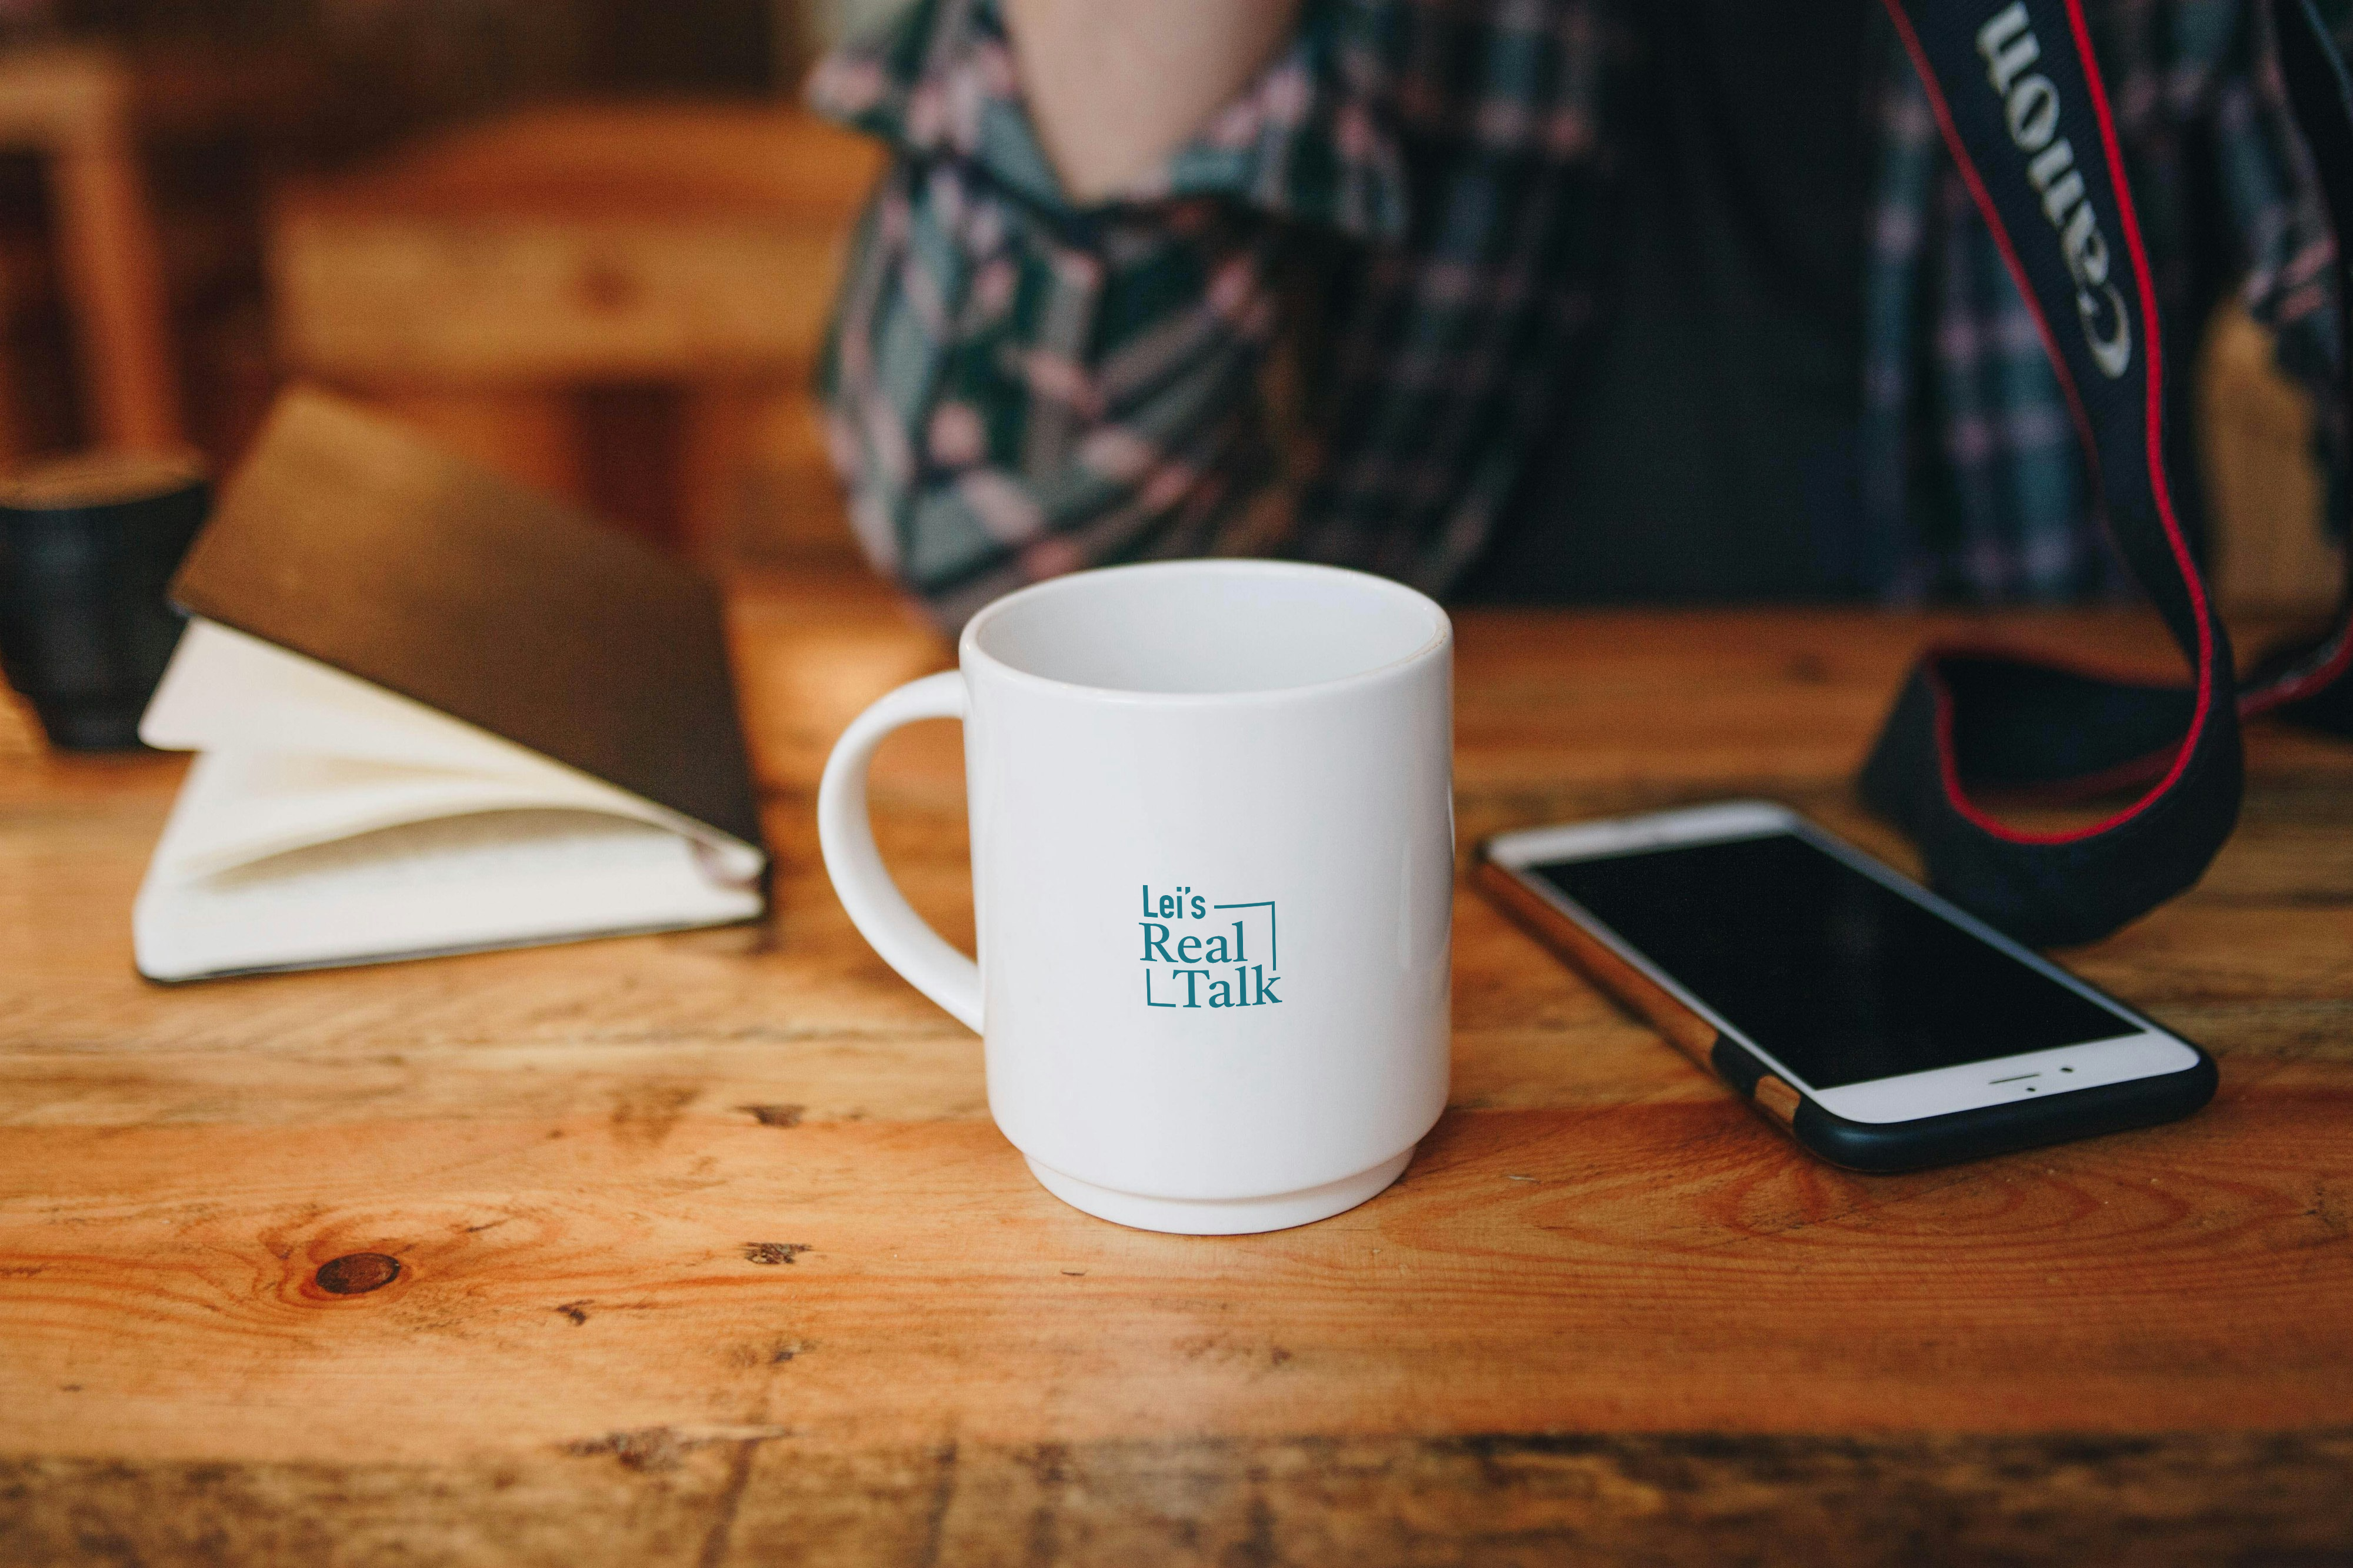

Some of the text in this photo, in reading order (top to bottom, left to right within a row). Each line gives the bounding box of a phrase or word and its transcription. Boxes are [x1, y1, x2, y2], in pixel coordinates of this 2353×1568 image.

[1975, 0, 2132, 378] Canon
[1142, 884, 1207, 920] Lei's
[1138, 920, 1248, 964] Real
[1172, 964, 1283, 1008] Talk
